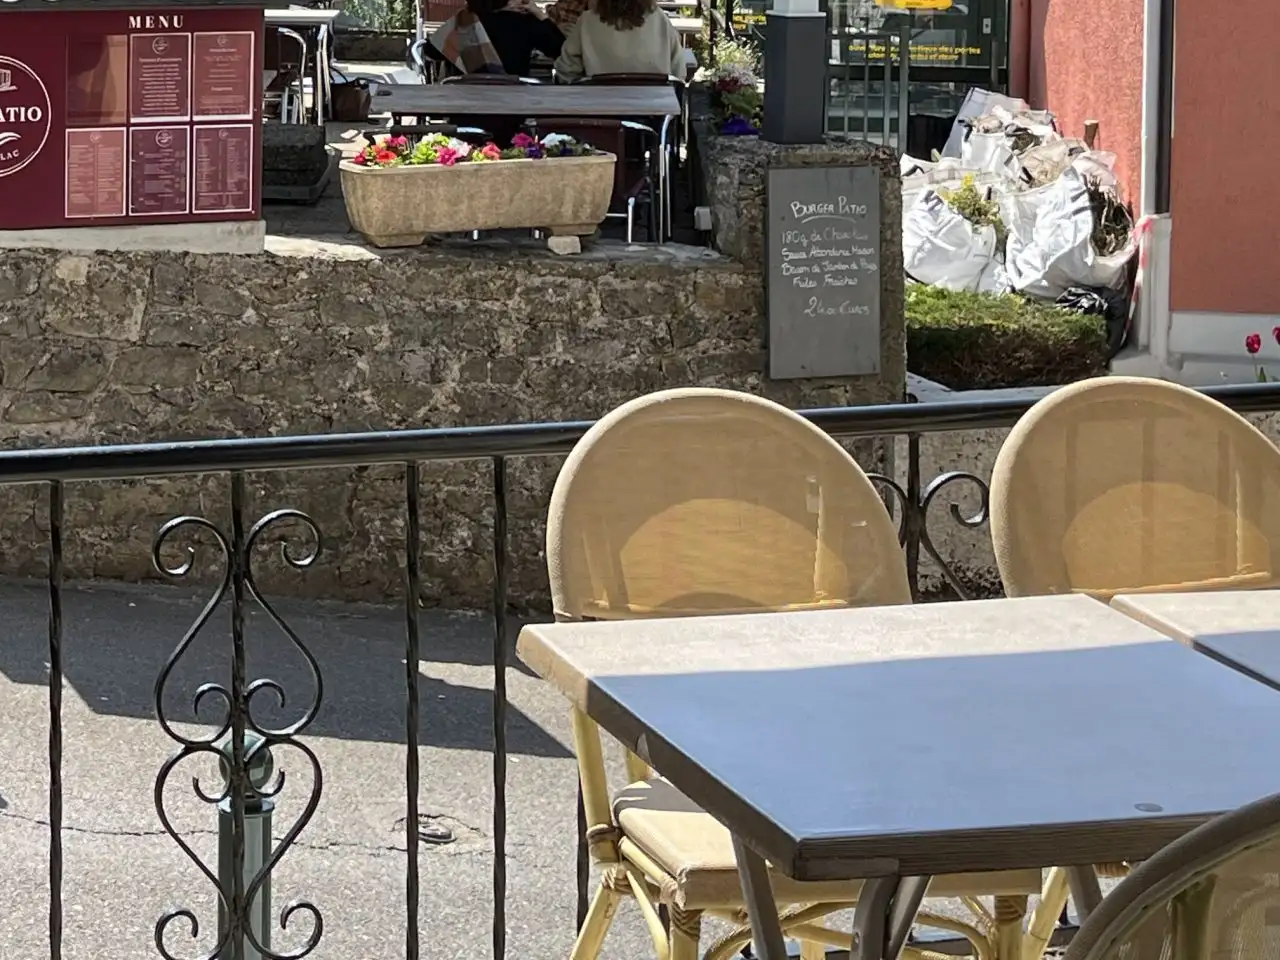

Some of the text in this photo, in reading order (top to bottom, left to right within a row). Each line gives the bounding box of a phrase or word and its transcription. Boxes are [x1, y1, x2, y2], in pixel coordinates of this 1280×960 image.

[128, 14, 184, 29] MENU
[0, 149, 21, 161] LAC
[790, 195, 868, 218] BURGER PATIO
